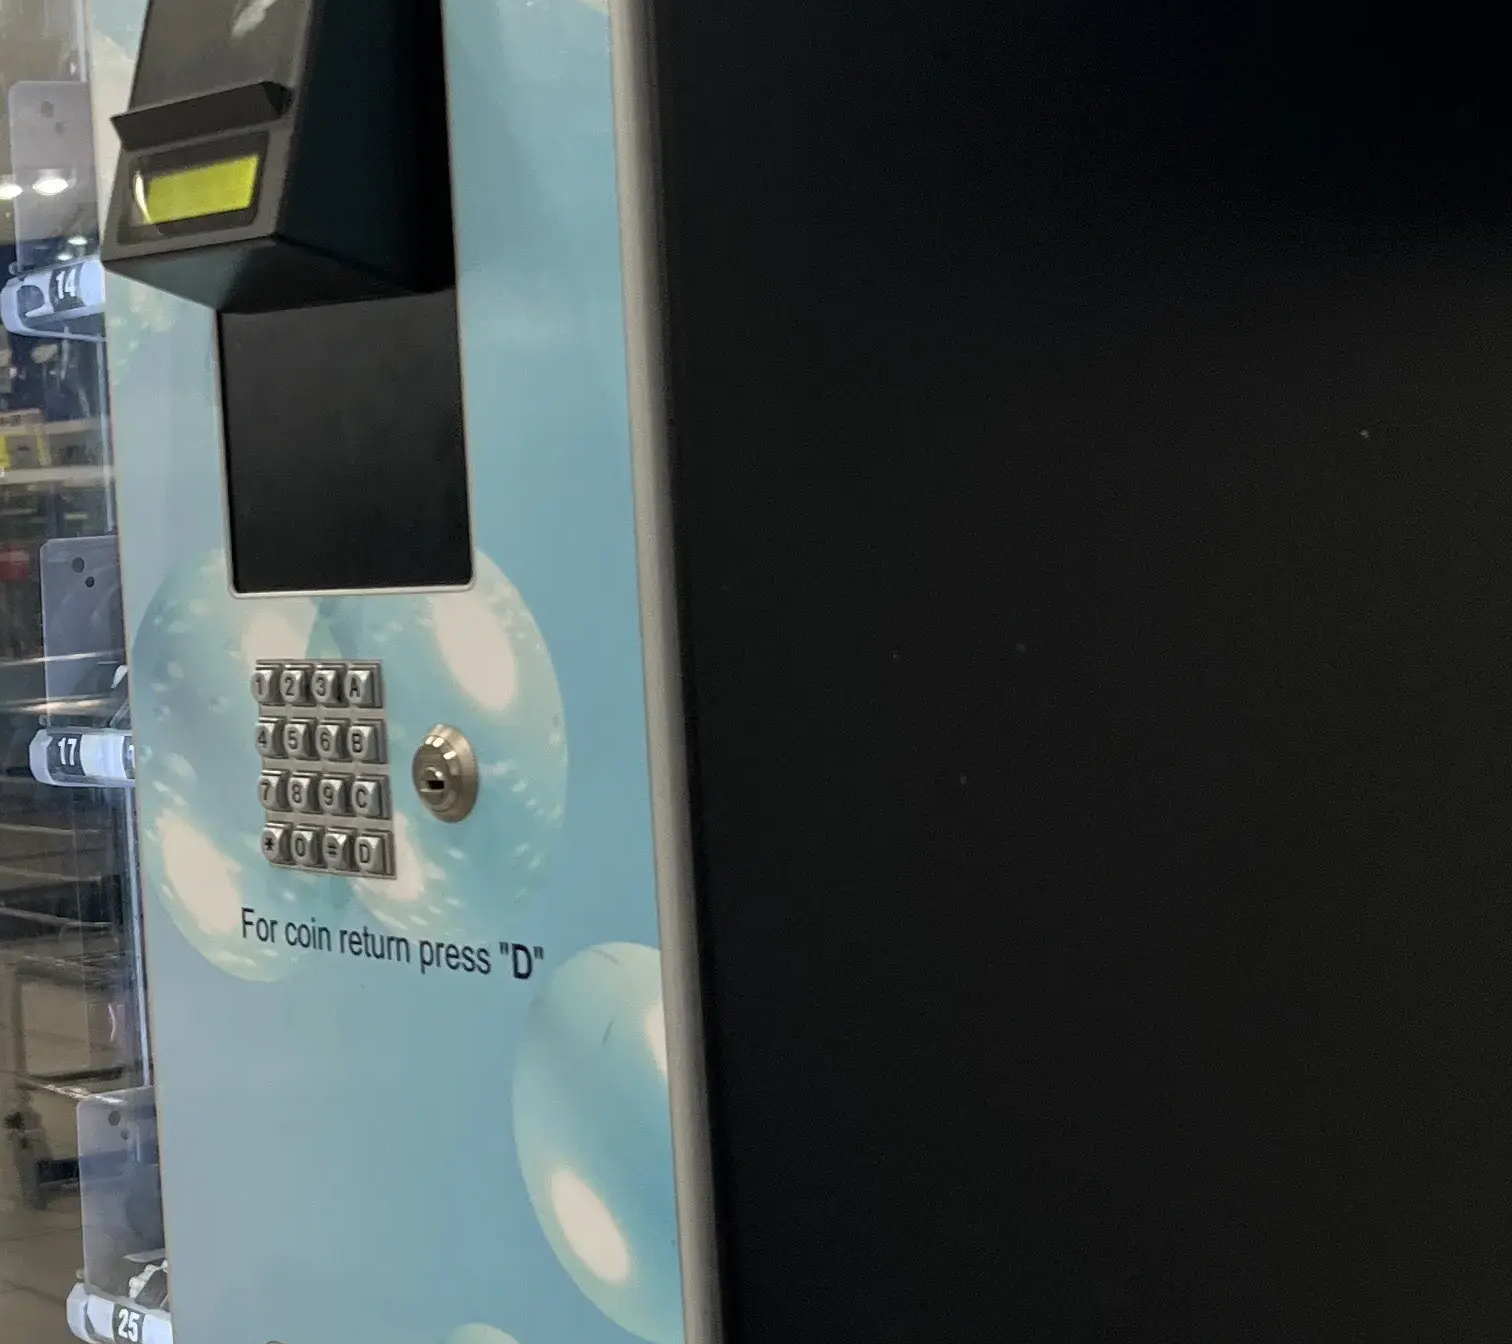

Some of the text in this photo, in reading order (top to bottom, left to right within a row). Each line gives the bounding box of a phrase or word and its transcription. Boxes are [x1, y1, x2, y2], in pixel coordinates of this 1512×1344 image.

[54, 268, 78, 300] 14
[284, 675, 295, 697] 2
[315, 676, 326, 698] 3
[349, 676, 361, 698] A
[57, 736, 78, 767] 17
[257, 729, 363, 754] 4 5 6 B
[260, 781, 368, 809] 7 8 9 C
[359, 842, 371, 864] D
[240, 906, 545, 981] For coin return press "D"
[117, 1308, 140, 1343] 25
